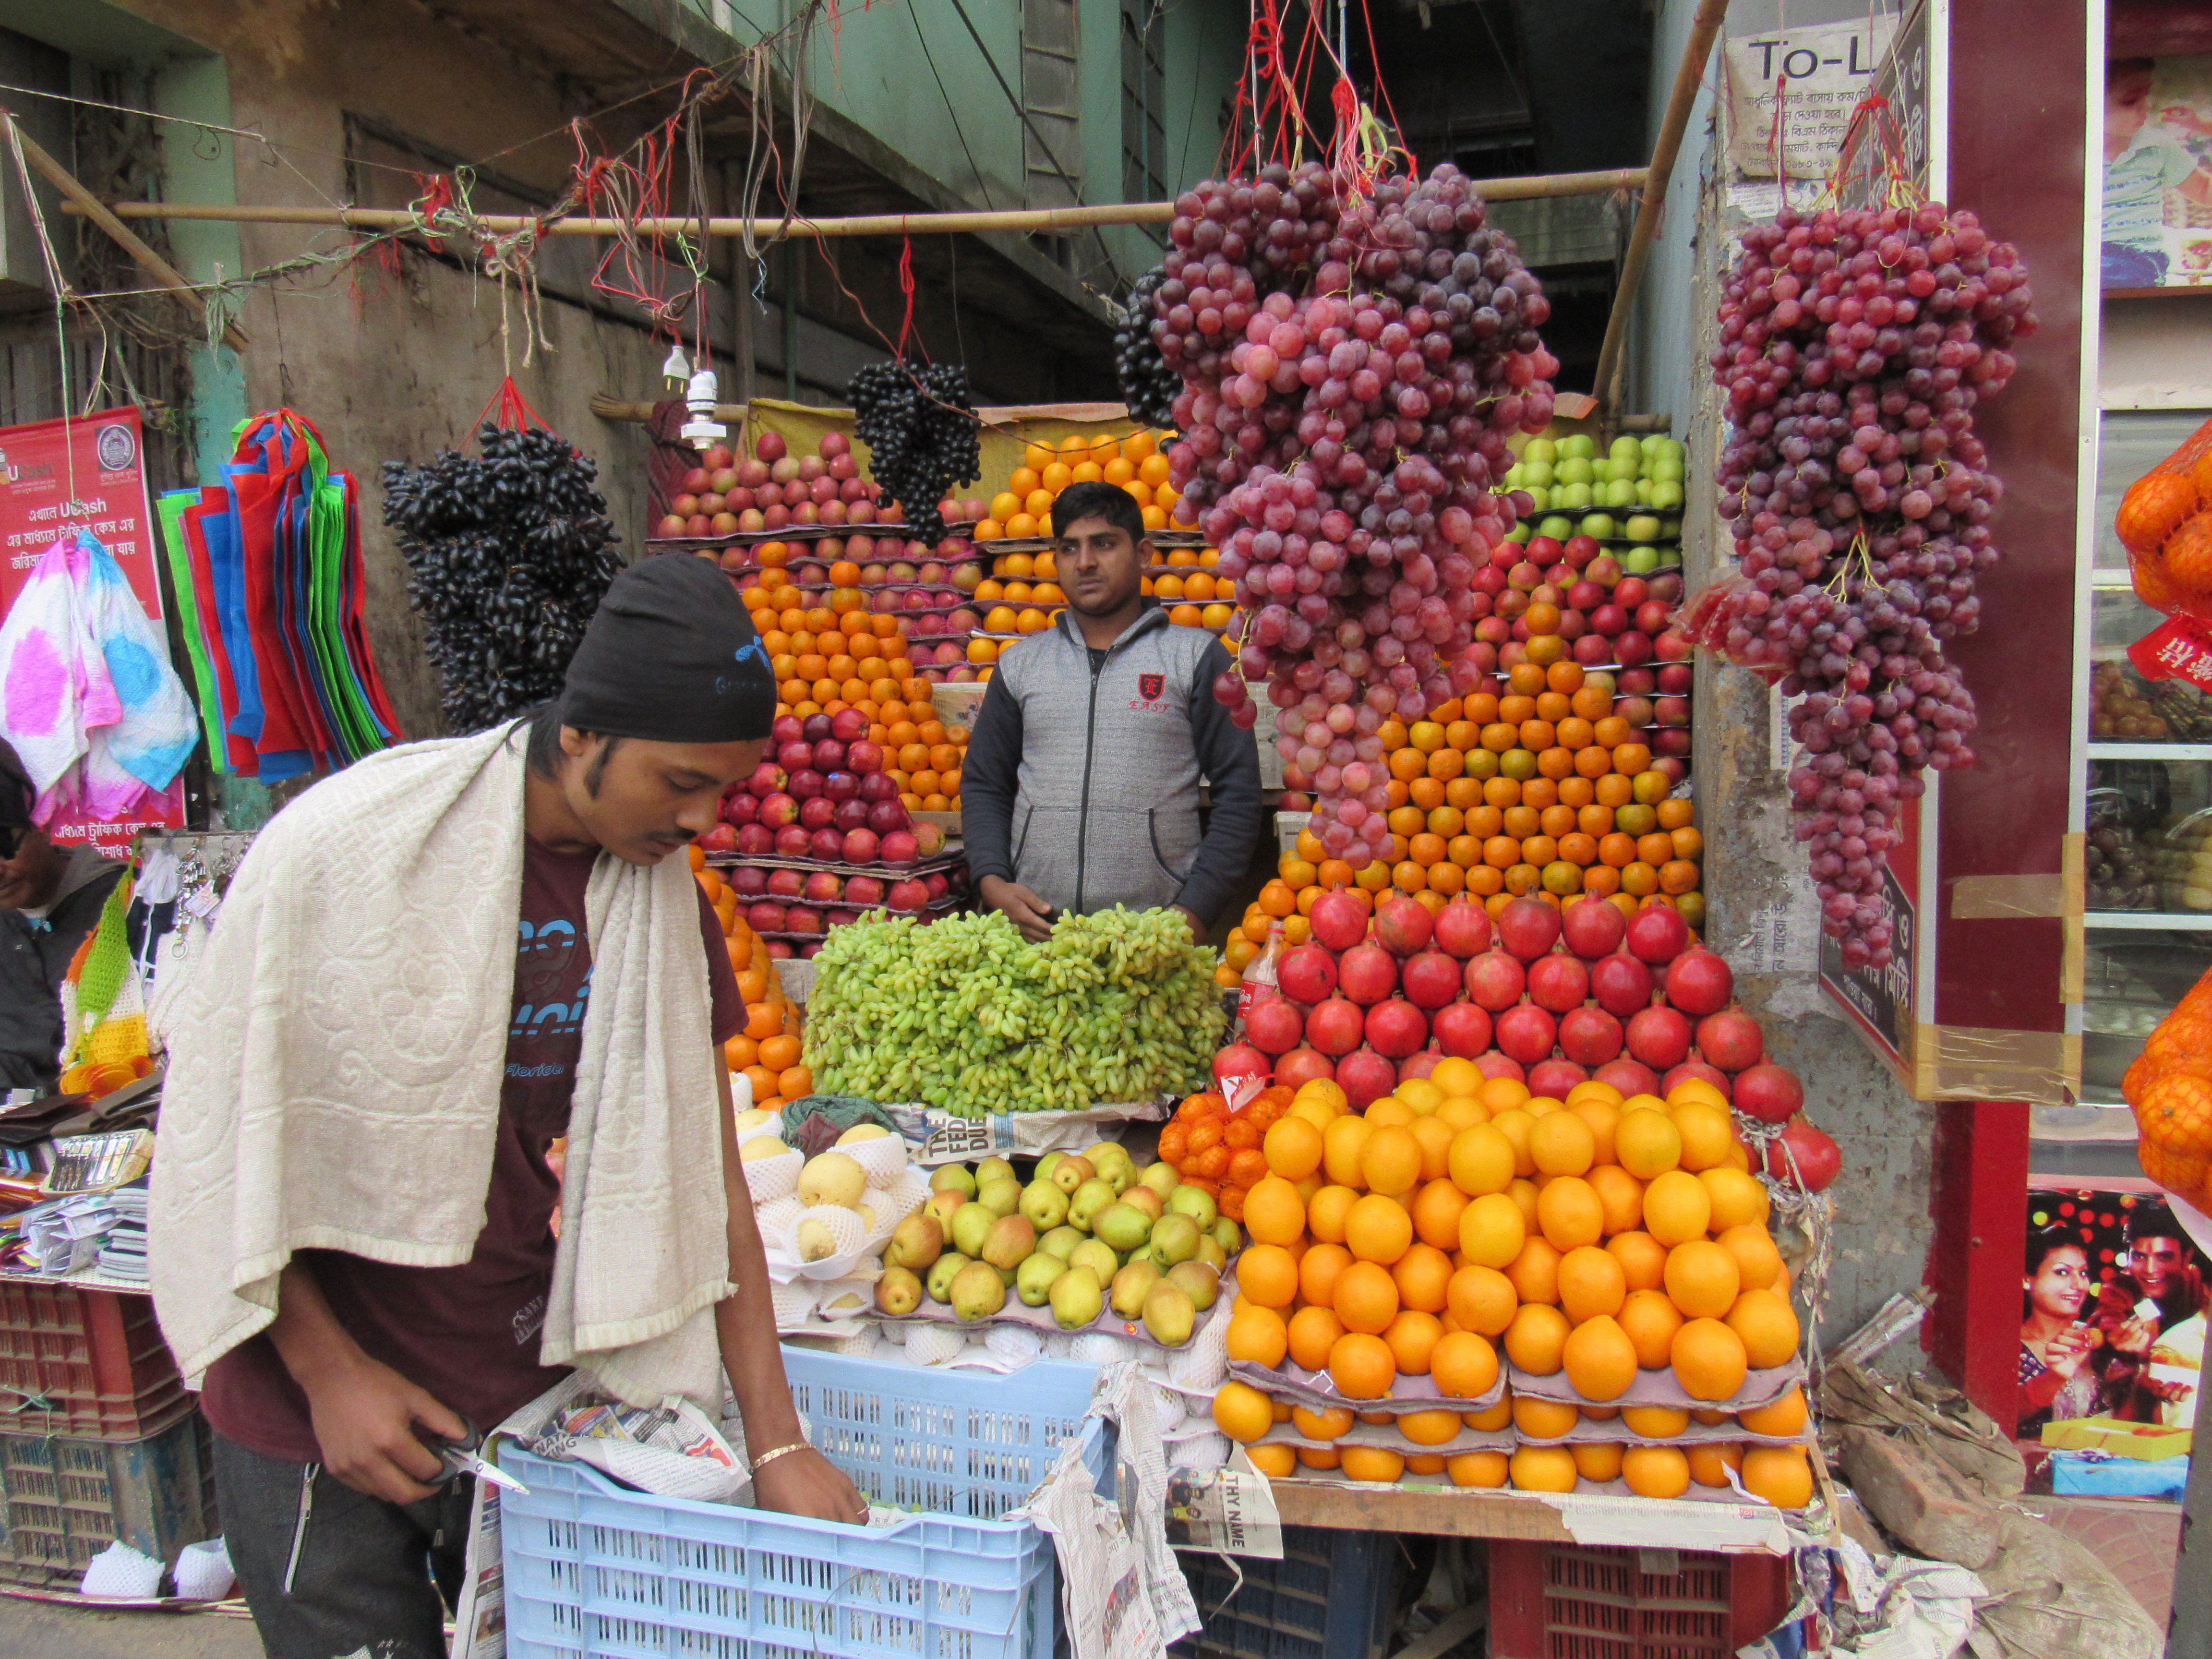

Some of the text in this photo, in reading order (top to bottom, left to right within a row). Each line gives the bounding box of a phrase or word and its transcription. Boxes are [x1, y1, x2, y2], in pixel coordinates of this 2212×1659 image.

[29, 506, 57, 522] এখানে
[7, 533, 22, 547] এর
[24, 529, 56, 545] মাধ্যমে
[95, 521, 116, 536] কেস
[120, 519, 135, 532] এর
[117, 541, 136, 555] যায়
[1129, 700, 1170, 714] EASY
[88, 821, 122, 842] ট্রাফিক
[505, 1062, 564, 1077] Florida
[947, 1114, 969, 1154] FED
[1226, 1475, 1245, 1548] THY NAME
